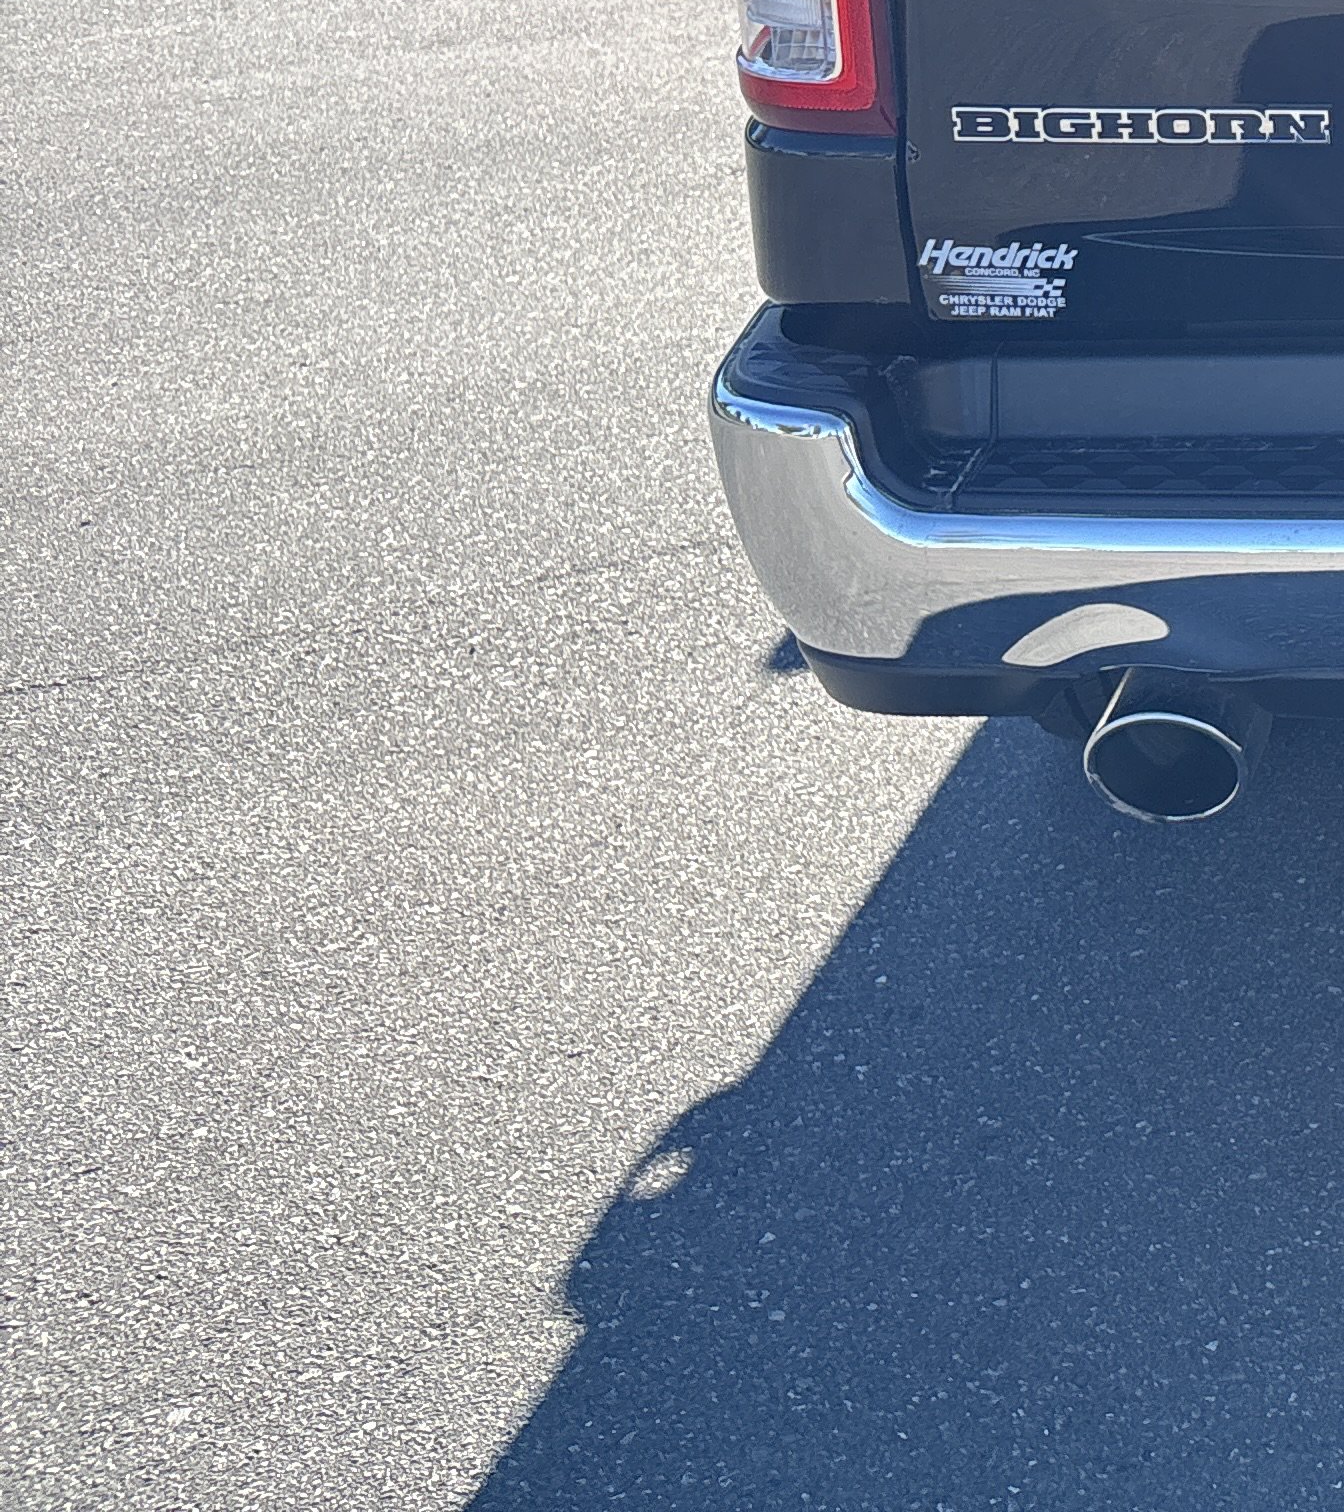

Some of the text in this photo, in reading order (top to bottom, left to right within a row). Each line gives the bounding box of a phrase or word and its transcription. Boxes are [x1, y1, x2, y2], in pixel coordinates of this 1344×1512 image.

[951, 106, 1331, 144] BIGHORN
[917, 238, 1079, 275] Hendrick
[964, 267, 1041, 277] CONCORD, NC
[938, 294, 1067, 308] CHRYSLER DODGE
[950, 306, 1057, 318] JEEP RAM FIAT
